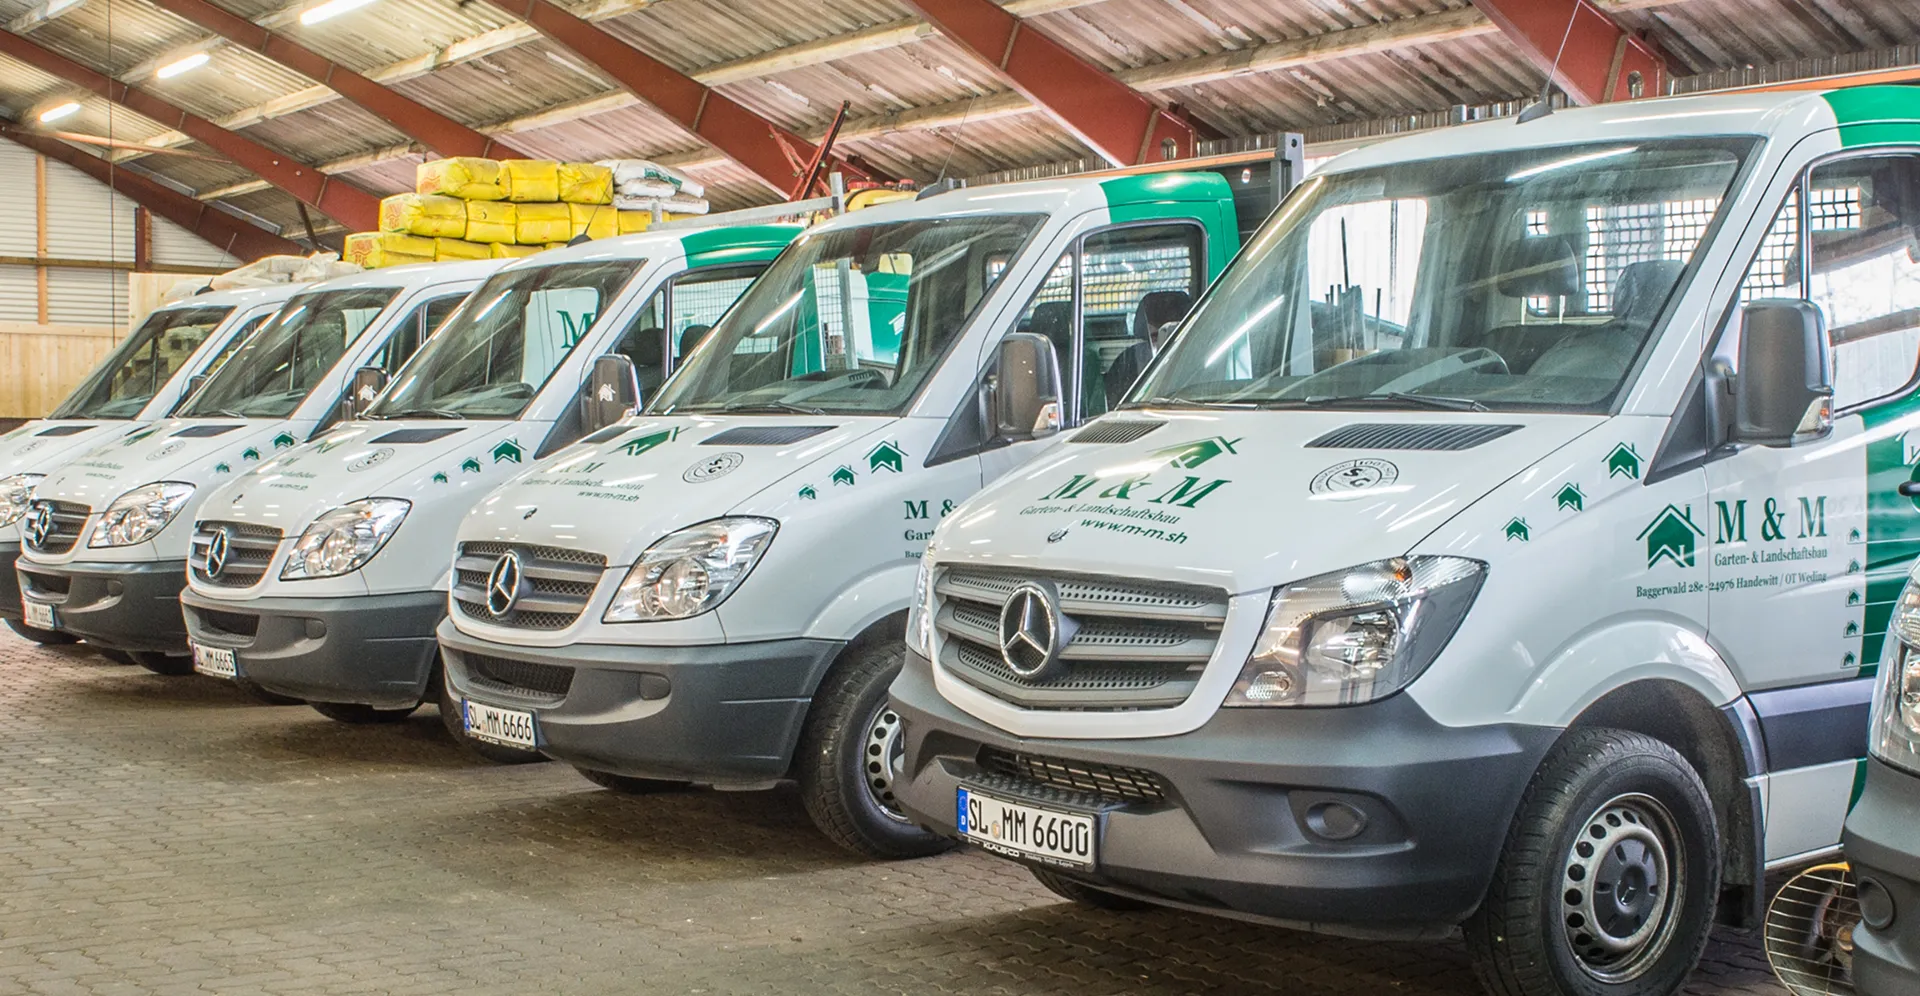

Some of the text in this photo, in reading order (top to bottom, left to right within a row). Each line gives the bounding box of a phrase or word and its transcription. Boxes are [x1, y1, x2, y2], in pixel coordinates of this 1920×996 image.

[1038, 473, 1233, 508] M & M
[903, 498, 958, 520] M &
[1019, 503, 1064, 516] Garten-
[1075, 502, 1181, 525] Landschaftsbau
[1714, 495, 1828, 544] M & M
[1080, 518, 1189, 546] www.m-m.sh
[1714, 545, 1829, 567] Garten- & Landschaftsbau
[1635, 581, 1687, 600] Baggerwald
[1688, 580, 1704, 593] 28e
[1736, 575, 1779, 589] Handewitt
[1785, 572, 1797, 584] OT
[1798, 570, 1828, 584] Weding
[469, 704, 532, 741] SL MM 6666
[968, 798, 1089, 857] SL MM 6600
